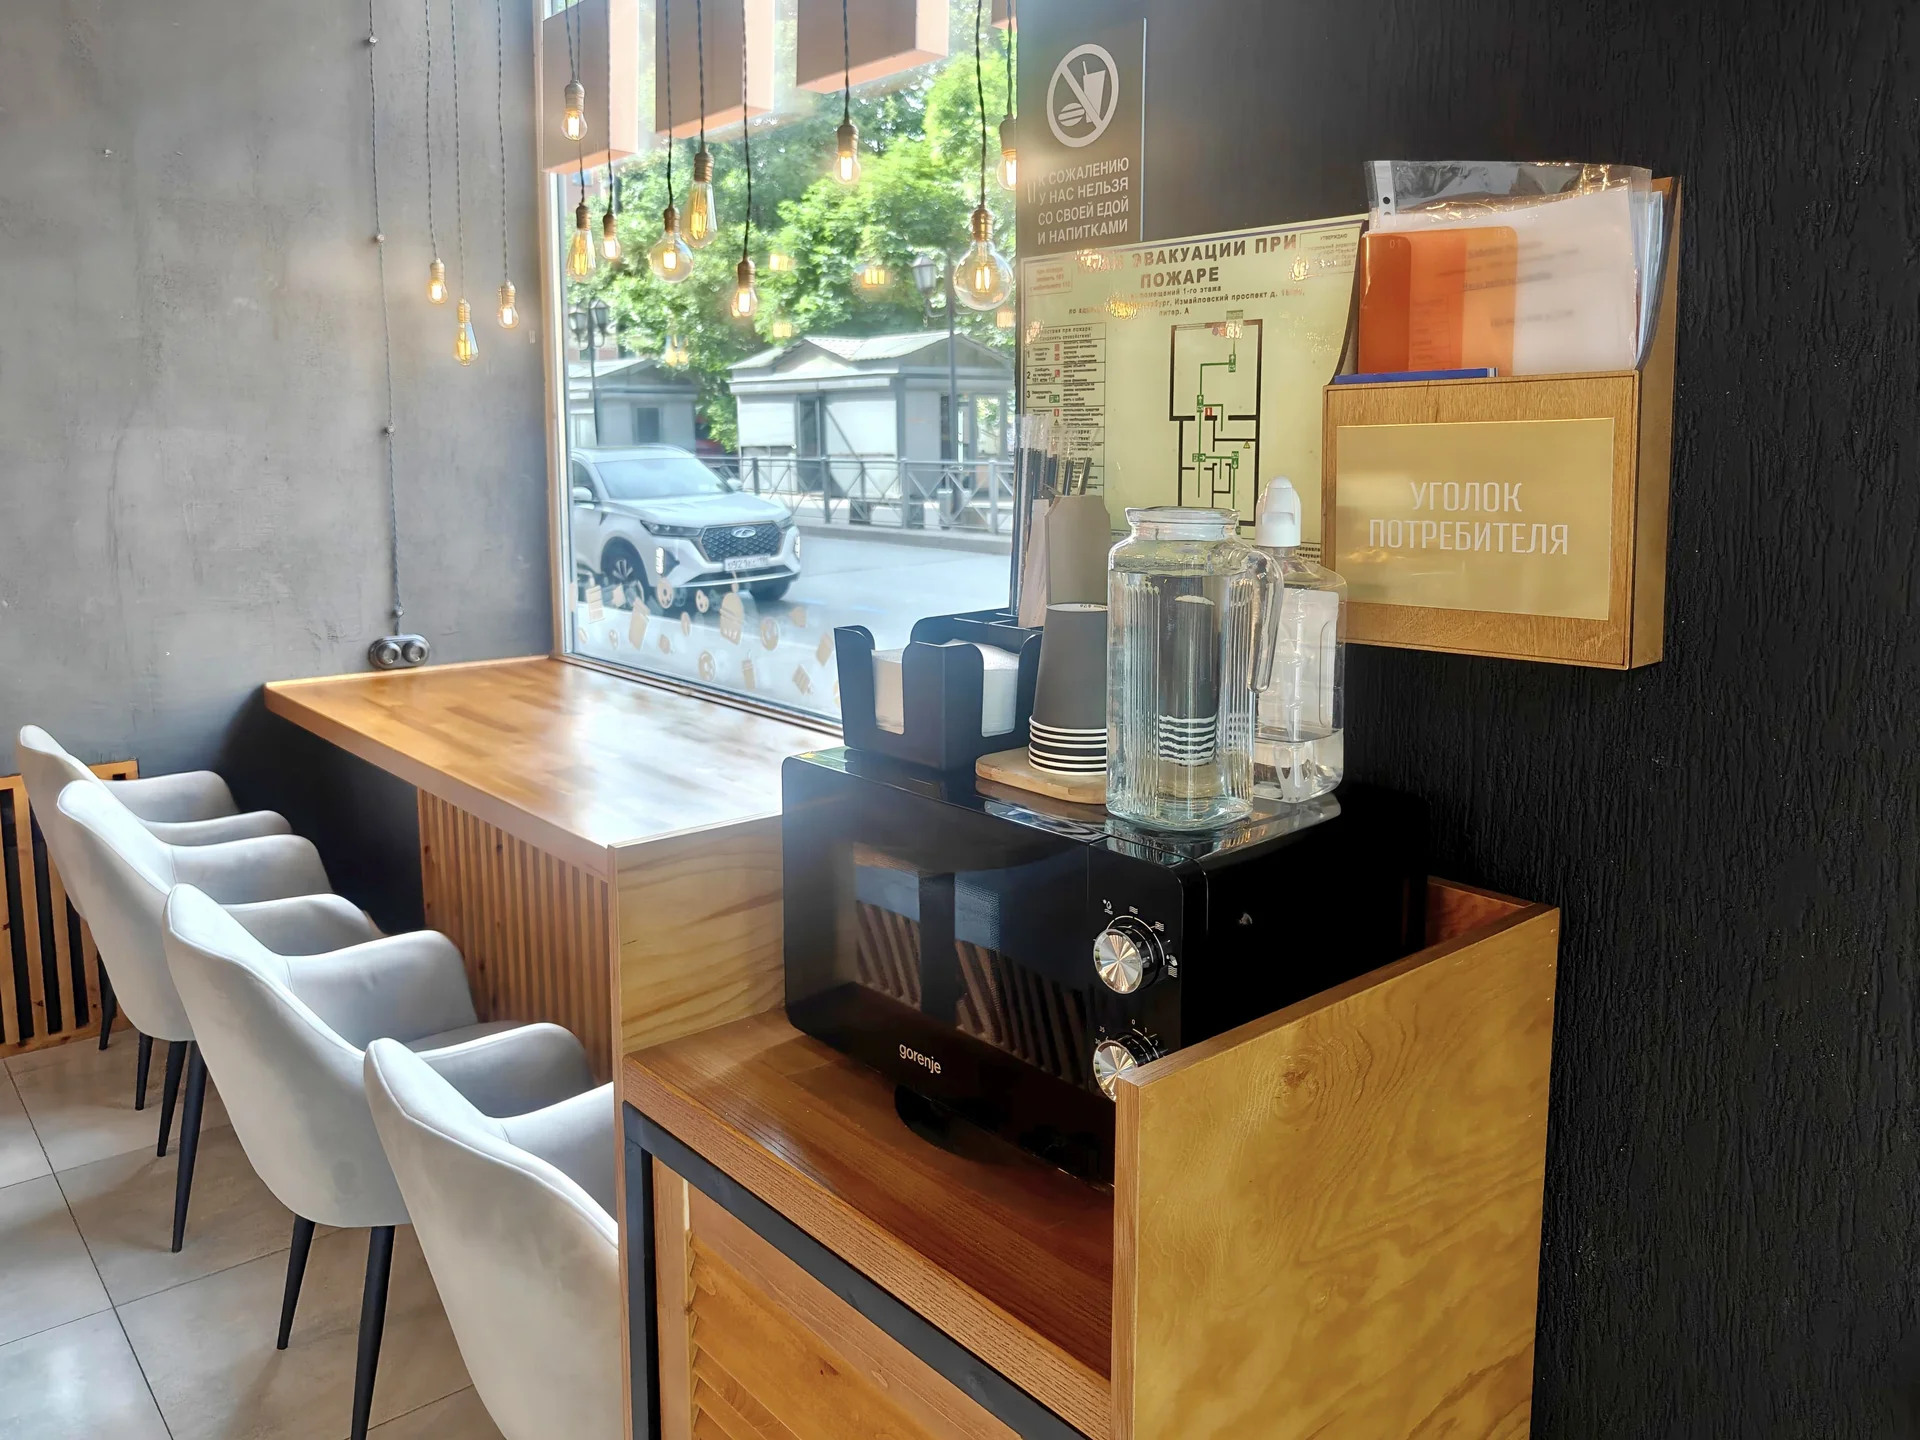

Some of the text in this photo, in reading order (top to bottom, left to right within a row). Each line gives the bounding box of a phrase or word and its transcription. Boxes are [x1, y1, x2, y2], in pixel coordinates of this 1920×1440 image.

[1048, 157, 1129, 185] СОЖАЛЕНИЮ
[1039, 176, 1129, 206] У НАС НЕЛЬЗЯ
[1038, 195, 1129, 226] СО СВОЕЙ ЕДОЙ
[1037, 218, 1128, 245] И НАПИТКАМИ
[1132, 240, 1246, 268] ЭВАКУАЦИИ
[1255, 234, 1297, 254] ПРИ
[1140, 266, 1219, 289] ПОЖАРЕ
[1231, 292, 1267, 302] проспект
[1410, 481, 1522, 512] УГОЛОК
[1369, 518, 1568, 555] ПОТРЕБИТЕЛЯ
[899, 1043, 942, 1075] gorenje
